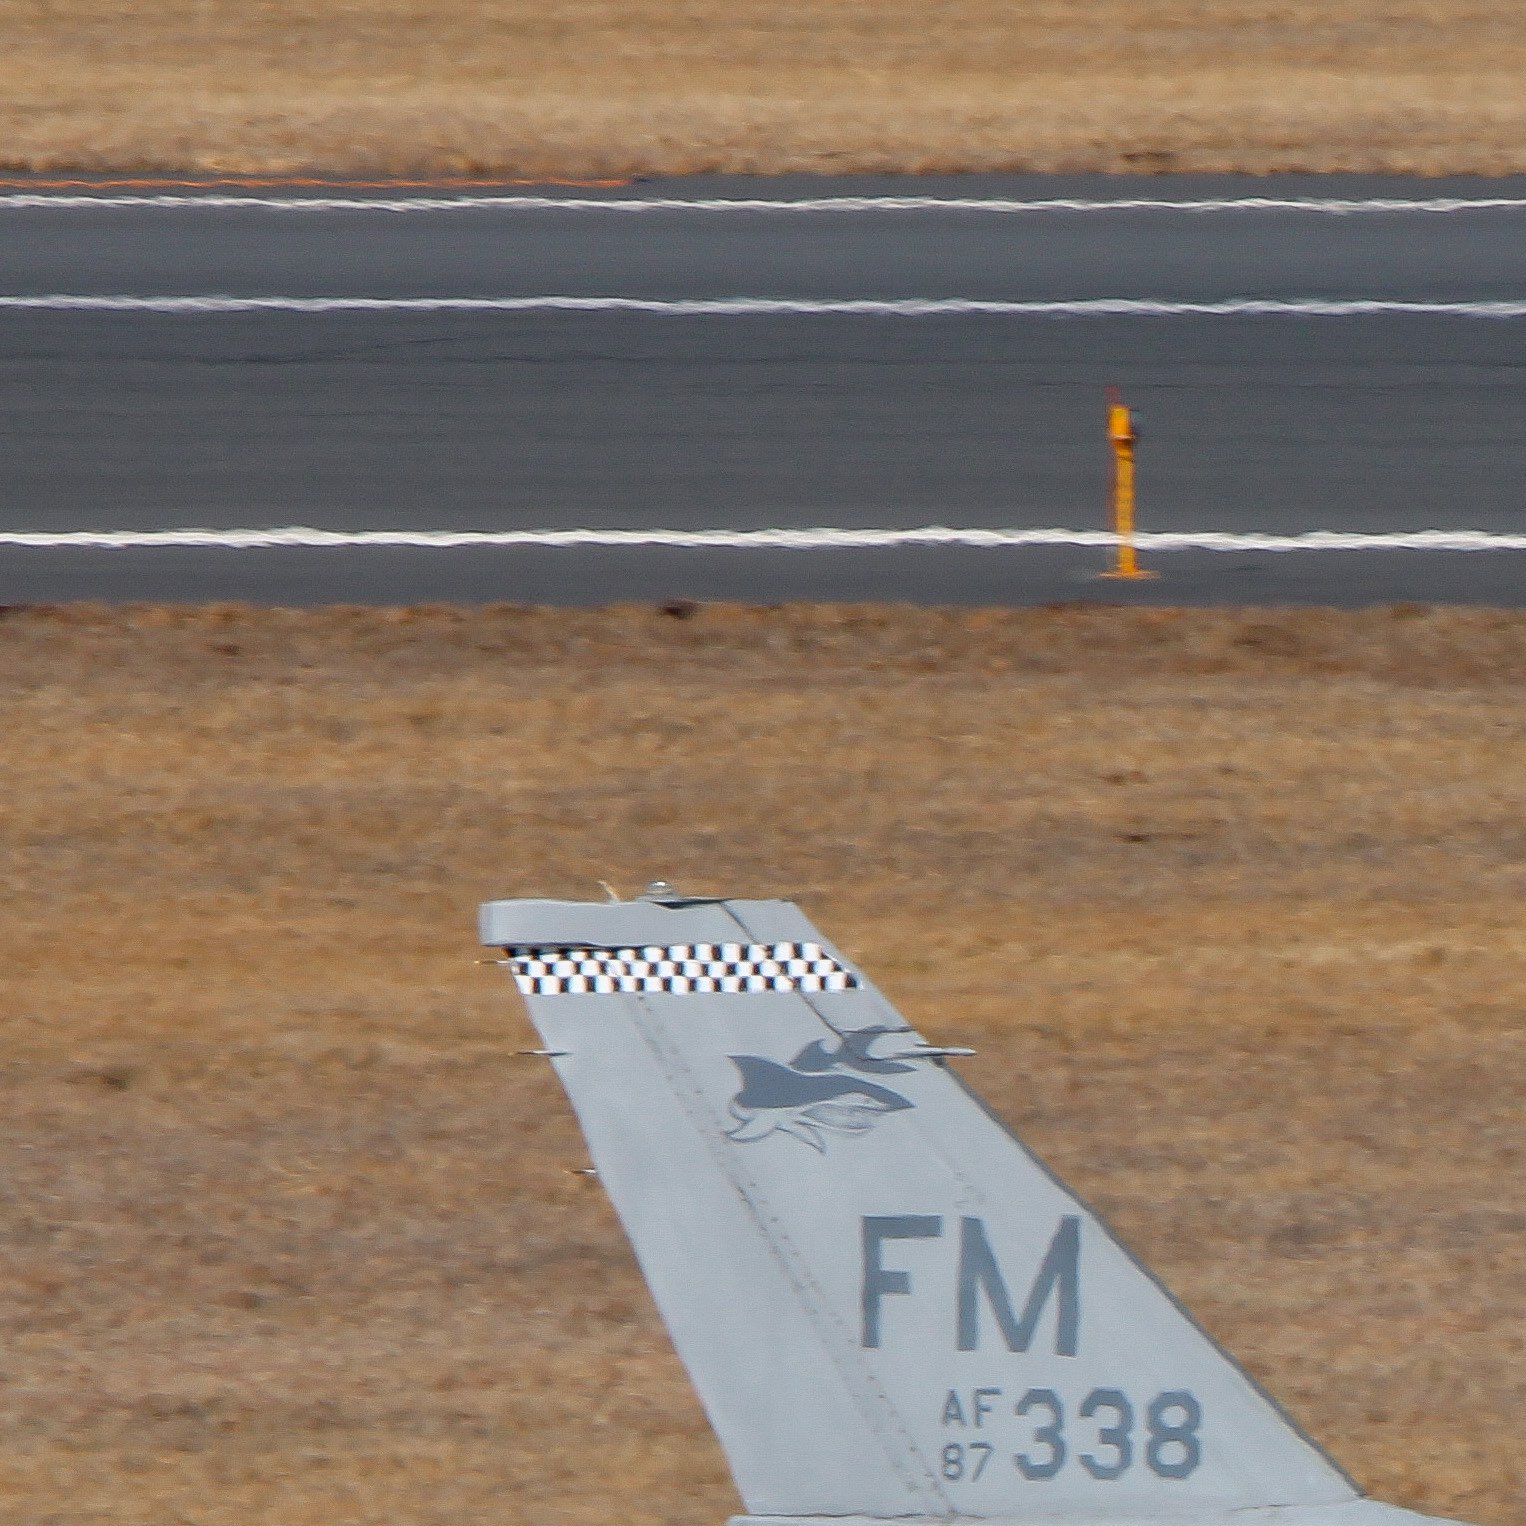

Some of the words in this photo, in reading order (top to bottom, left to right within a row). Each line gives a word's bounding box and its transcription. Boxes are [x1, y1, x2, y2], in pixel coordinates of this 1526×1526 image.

[861, 1214, 1081, 1356] FM
[942, 1387, 1001, 1428] AF
[1013, 1387, 1202, 1481] 338
[942, 1442, 995, 1482] 87
